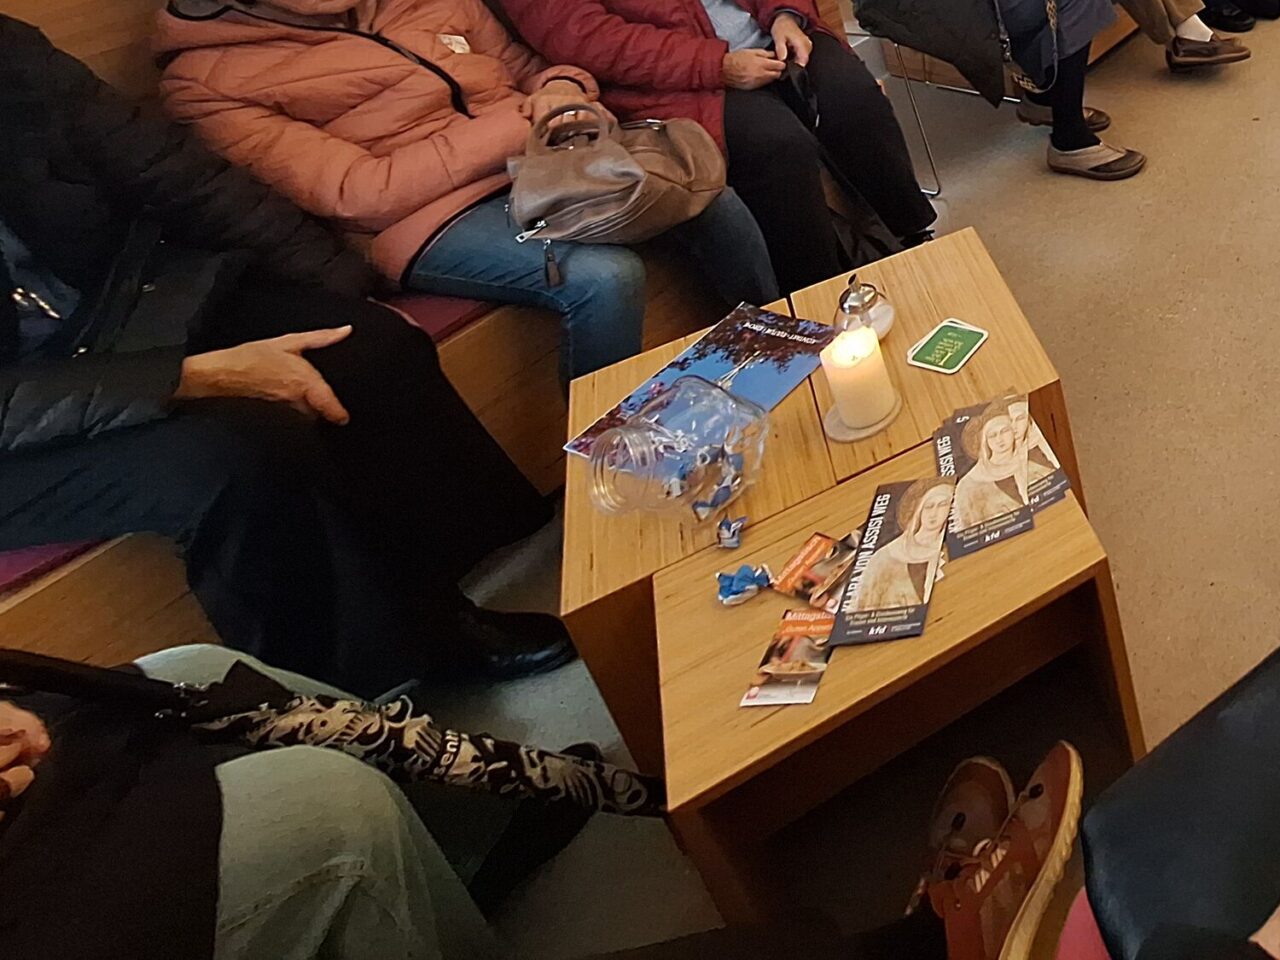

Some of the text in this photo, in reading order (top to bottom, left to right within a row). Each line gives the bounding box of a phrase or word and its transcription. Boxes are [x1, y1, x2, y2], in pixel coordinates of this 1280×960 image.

[939, 453, 956, 477] SSISI
[870, 493, 891, 517] WEG
[861, 516, 884, 549] ASSISI
[853, 551, 873, 575] VON
